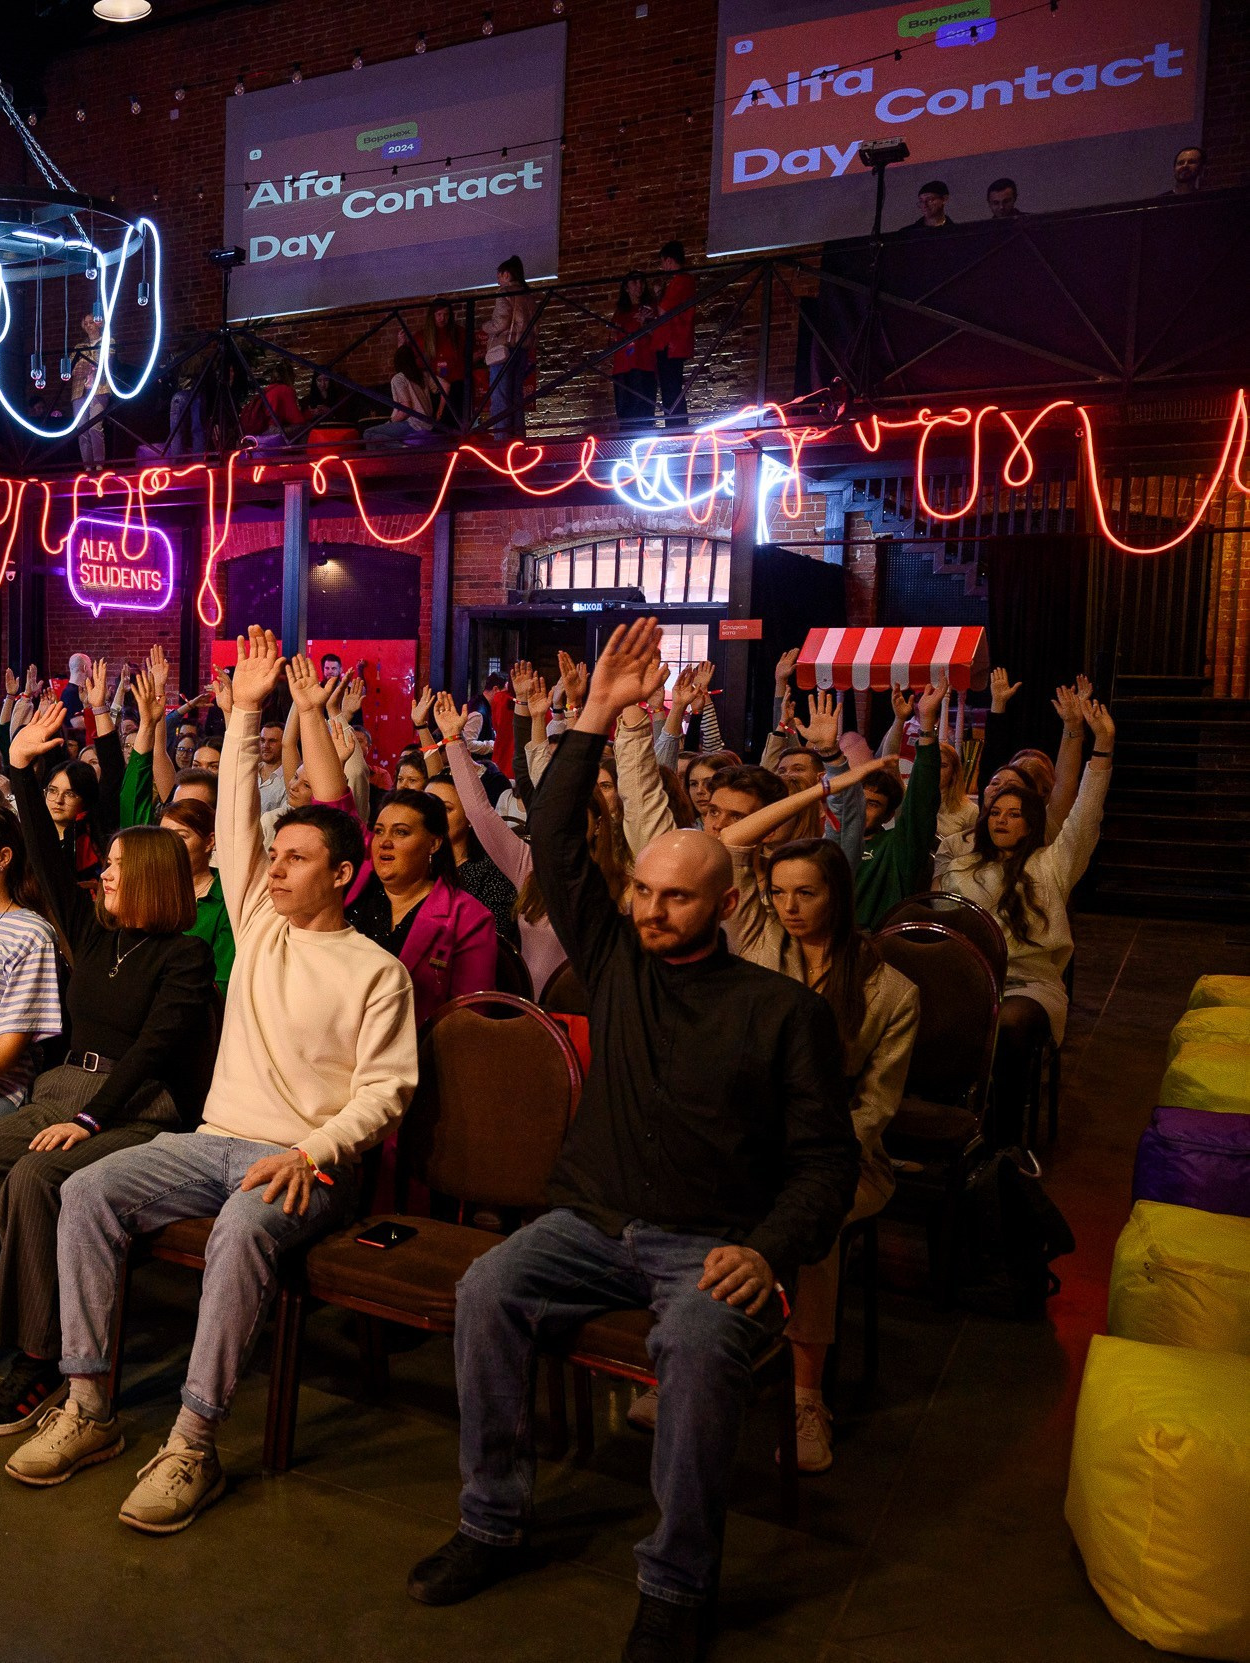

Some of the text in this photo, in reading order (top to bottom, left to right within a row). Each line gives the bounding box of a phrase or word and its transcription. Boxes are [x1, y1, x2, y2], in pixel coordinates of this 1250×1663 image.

[908, 7, 981, 29] Воронеж
[945, 26, 986, 39] 204
[731, 42, 1185, 124] Alfa Contact
[362, 128, 412, 145] Воронеж
[388, 142, 415, 154] 2024
[732, 139, 864, 184] Day
[248, 161, 544, 219] Alfa Contact
[249, 230, 336, 264] Day
[79, 538, 118, 563] ALFA
[79, 563, 162, 591] STUDENTS
[573, 603, 603, 611] ЫХОД
